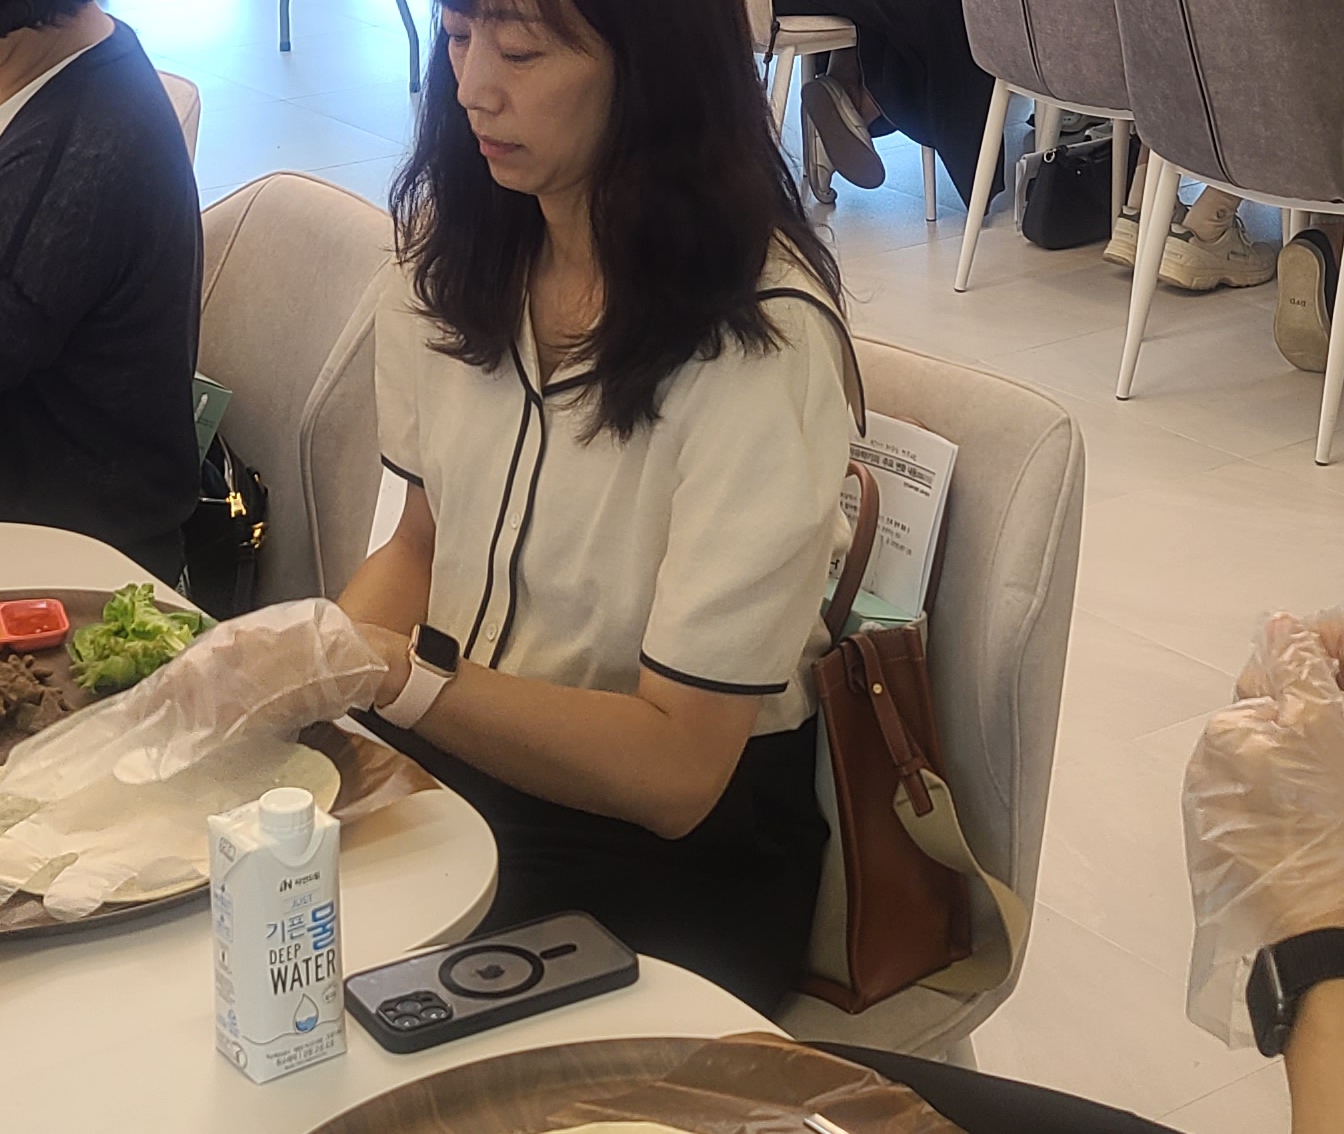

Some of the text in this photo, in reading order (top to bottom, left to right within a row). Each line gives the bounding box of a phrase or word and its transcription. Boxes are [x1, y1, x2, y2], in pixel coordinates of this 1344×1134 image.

[266, 900, 336, 951] 기픈 물
[269, 943, 301, 965] DEEP
[270, 948, 336, 995] WATER
